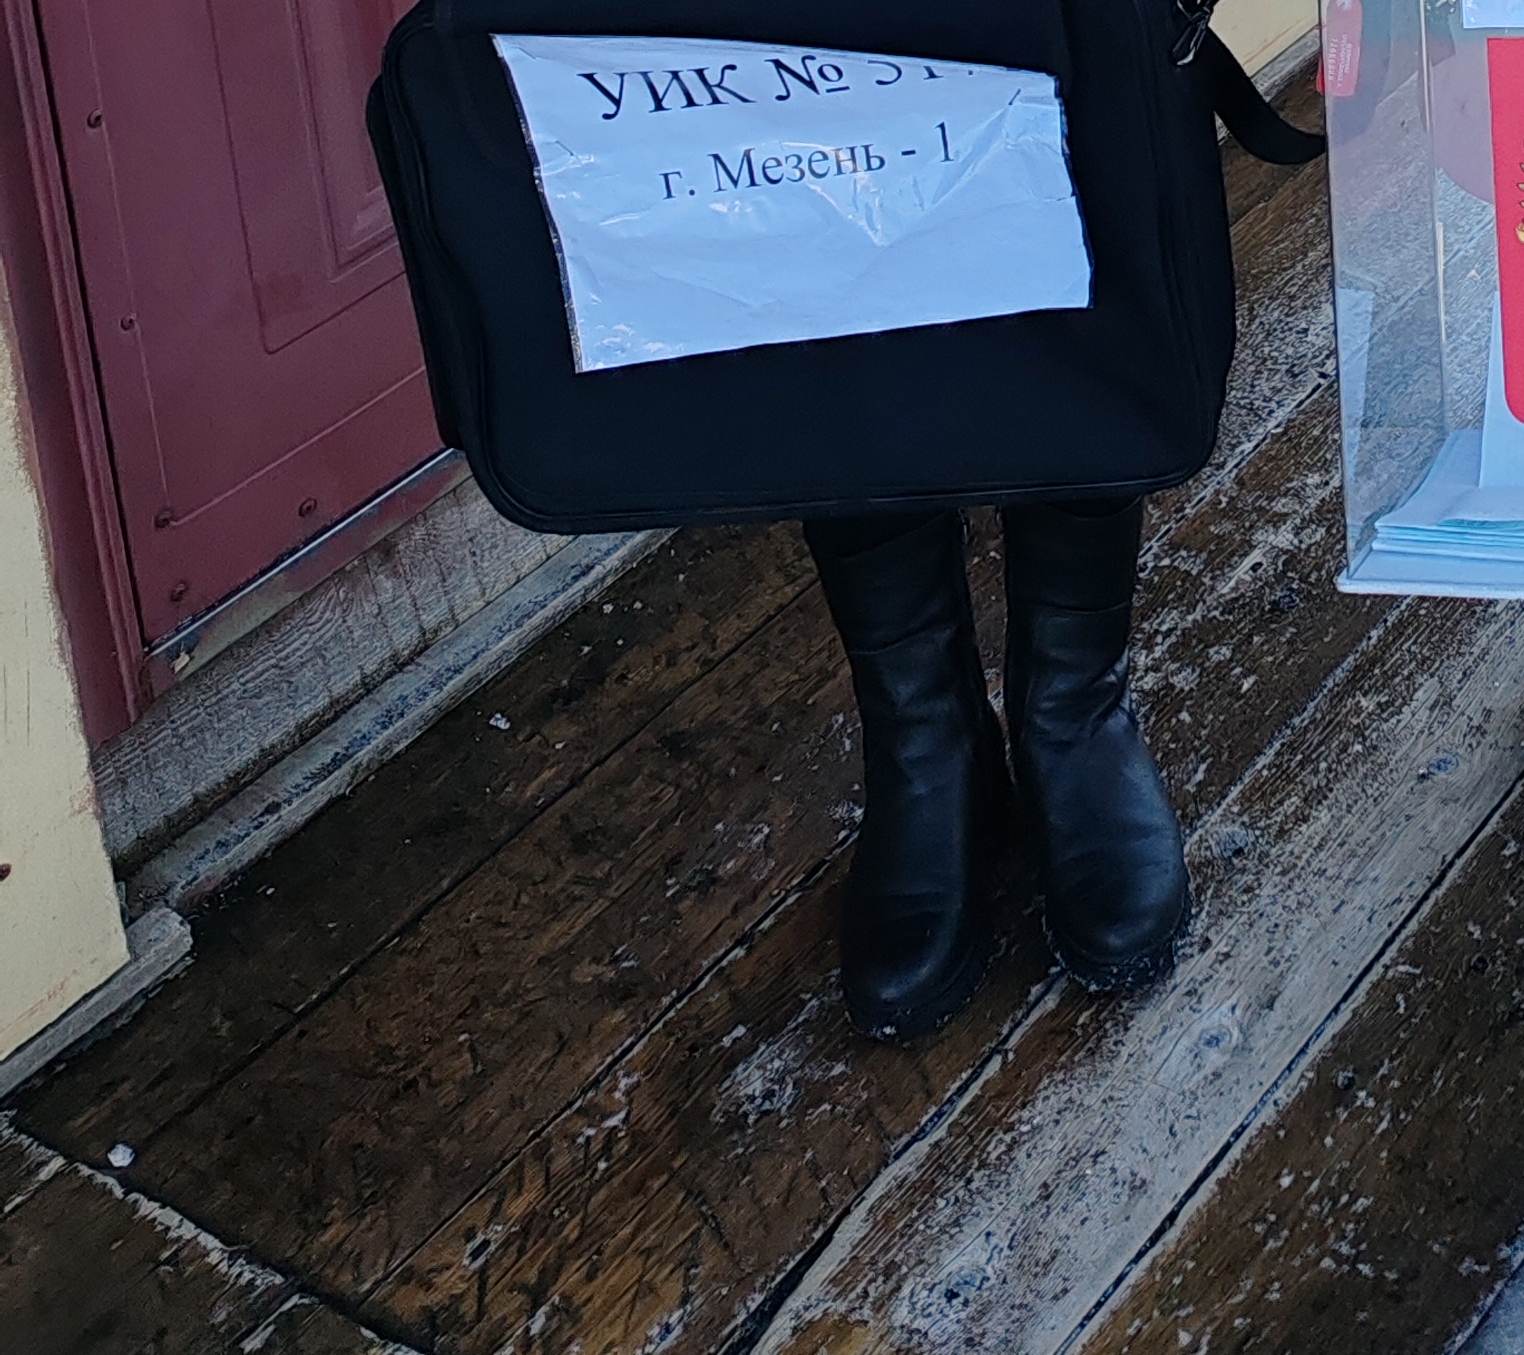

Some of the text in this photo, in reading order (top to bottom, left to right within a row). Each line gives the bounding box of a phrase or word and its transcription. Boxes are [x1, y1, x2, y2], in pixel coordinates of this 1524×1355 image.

[577, 64, 757, 120] УИК
[764, 55, 851, 101] №
[658, 171, 696, 200] г.
[707, 143, 886, 193] Мезень
[934, 122, 954, 163] 1
